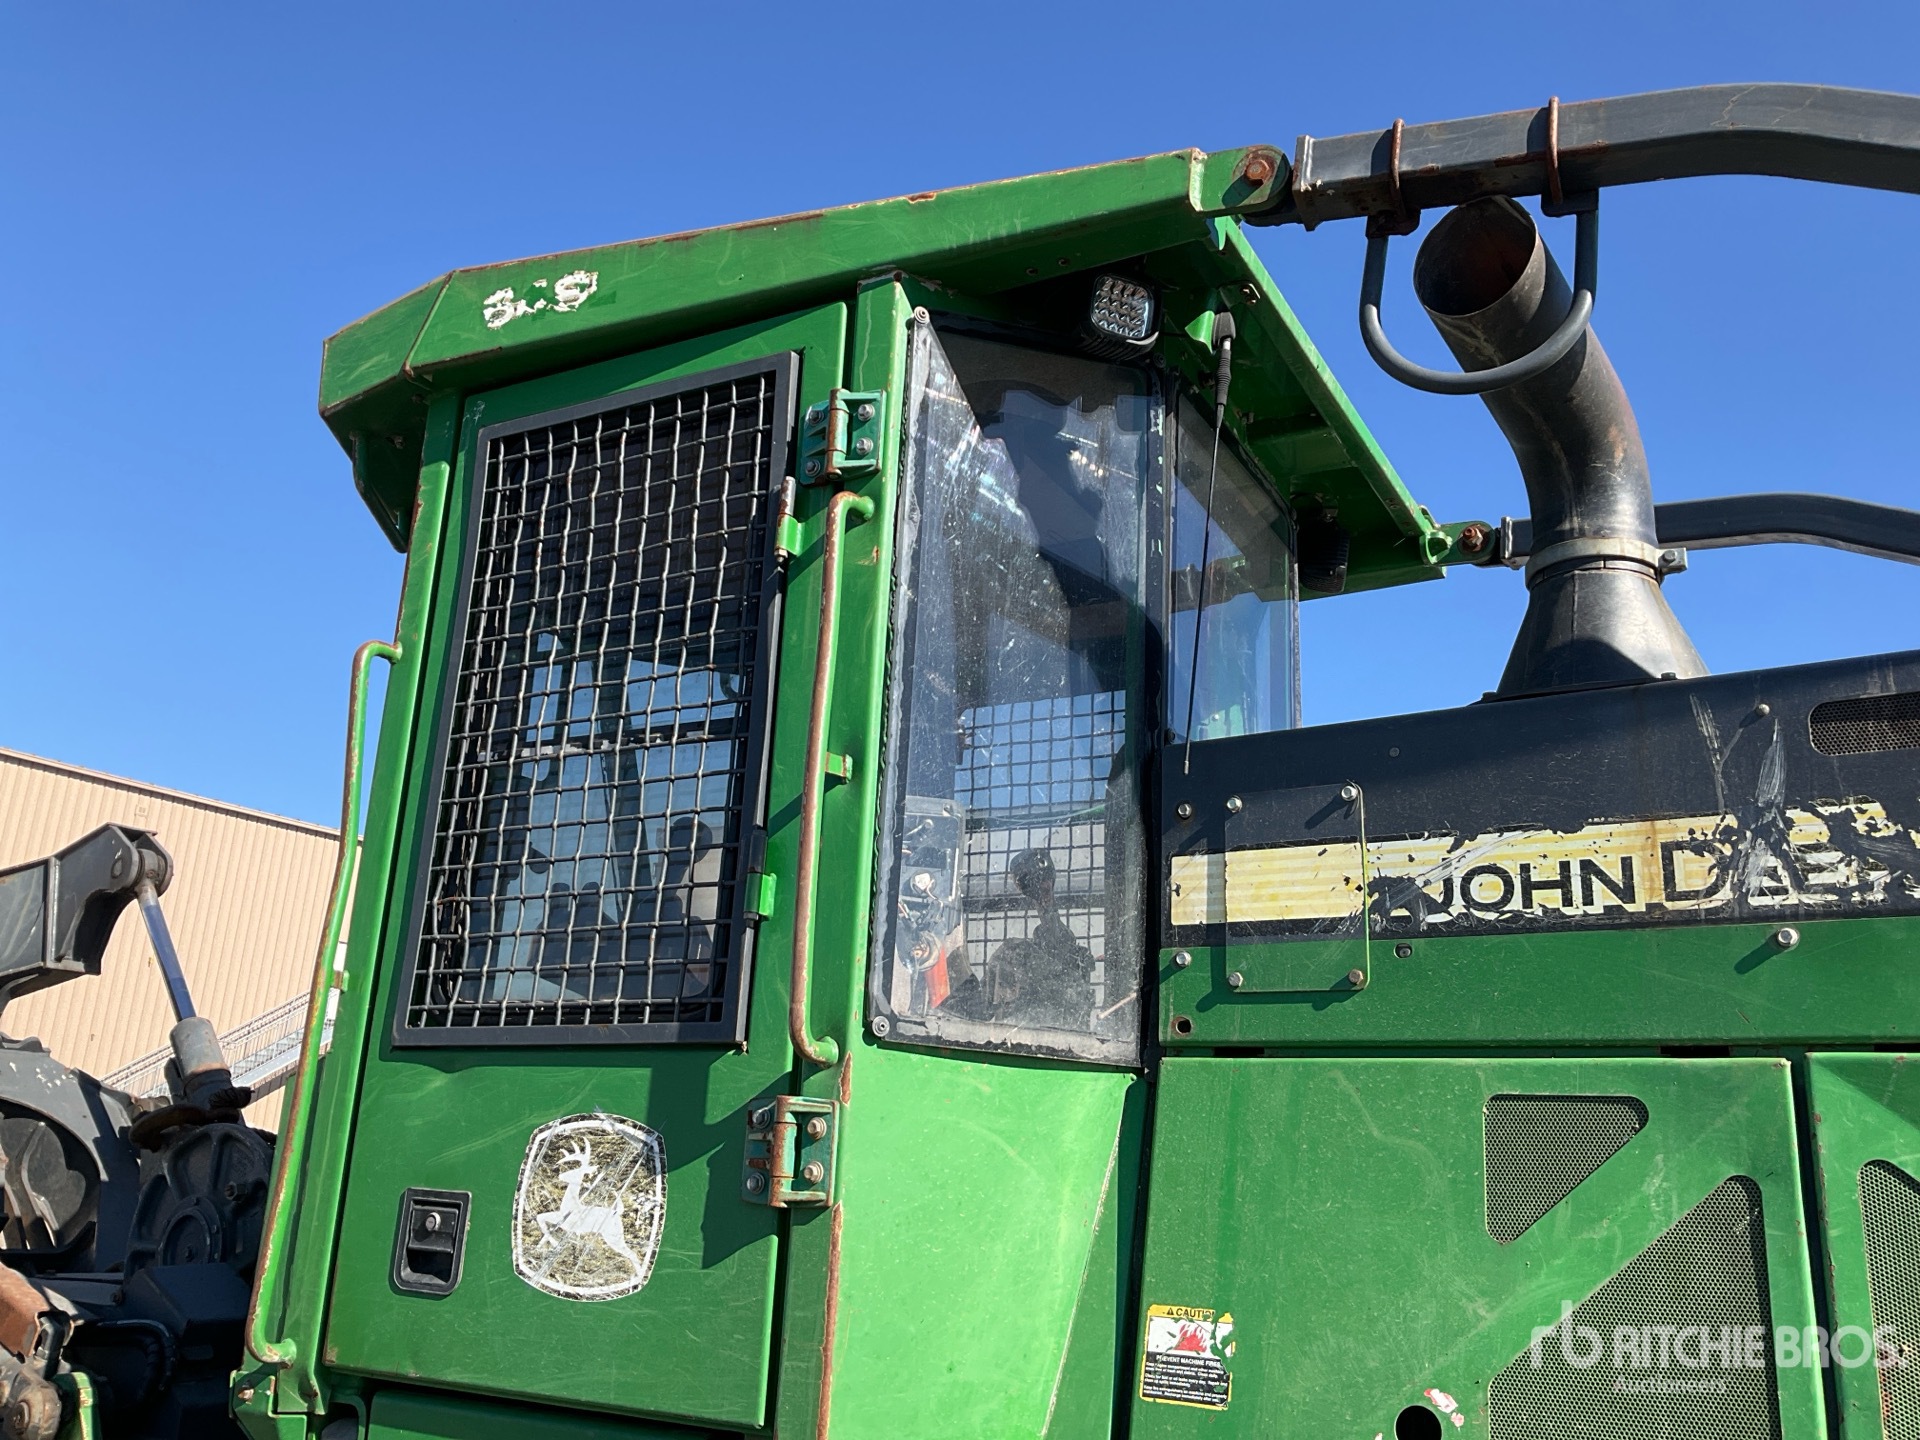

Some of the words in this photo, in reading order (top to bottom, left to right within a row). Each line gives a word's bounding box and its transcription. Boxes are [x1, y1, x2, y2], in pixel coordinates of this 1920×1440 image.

[1430, 856, 1636, 912] JOHN
[1175, 1308, 1214, 1319] CAUT
[1180, 1357, 1204, 1366] MACHINE
